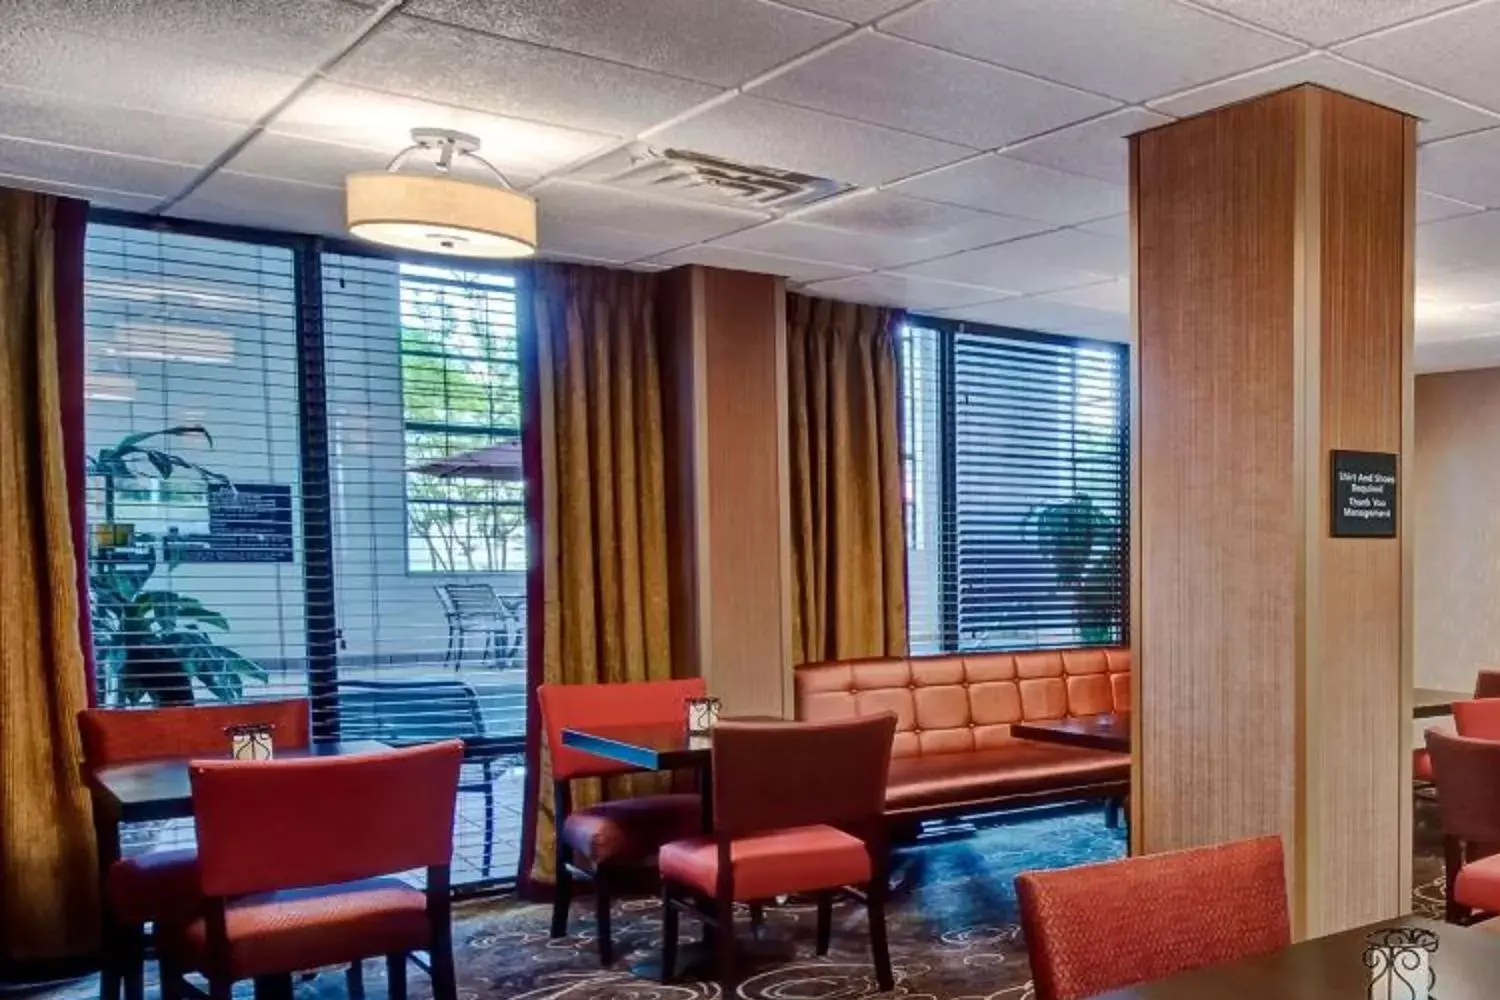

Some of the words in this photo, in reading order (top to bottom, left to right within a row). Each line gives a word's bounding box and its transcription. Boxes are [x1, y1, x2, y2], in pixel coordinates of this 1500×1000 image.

[1358, 473, 1373, 482] And
[1351, 483, 1384, 494] Required
[1349, 497, 1370, 507] Thank
[1371, 497, 1387, 507] You
[1343, 507, 1391, 518] Management
